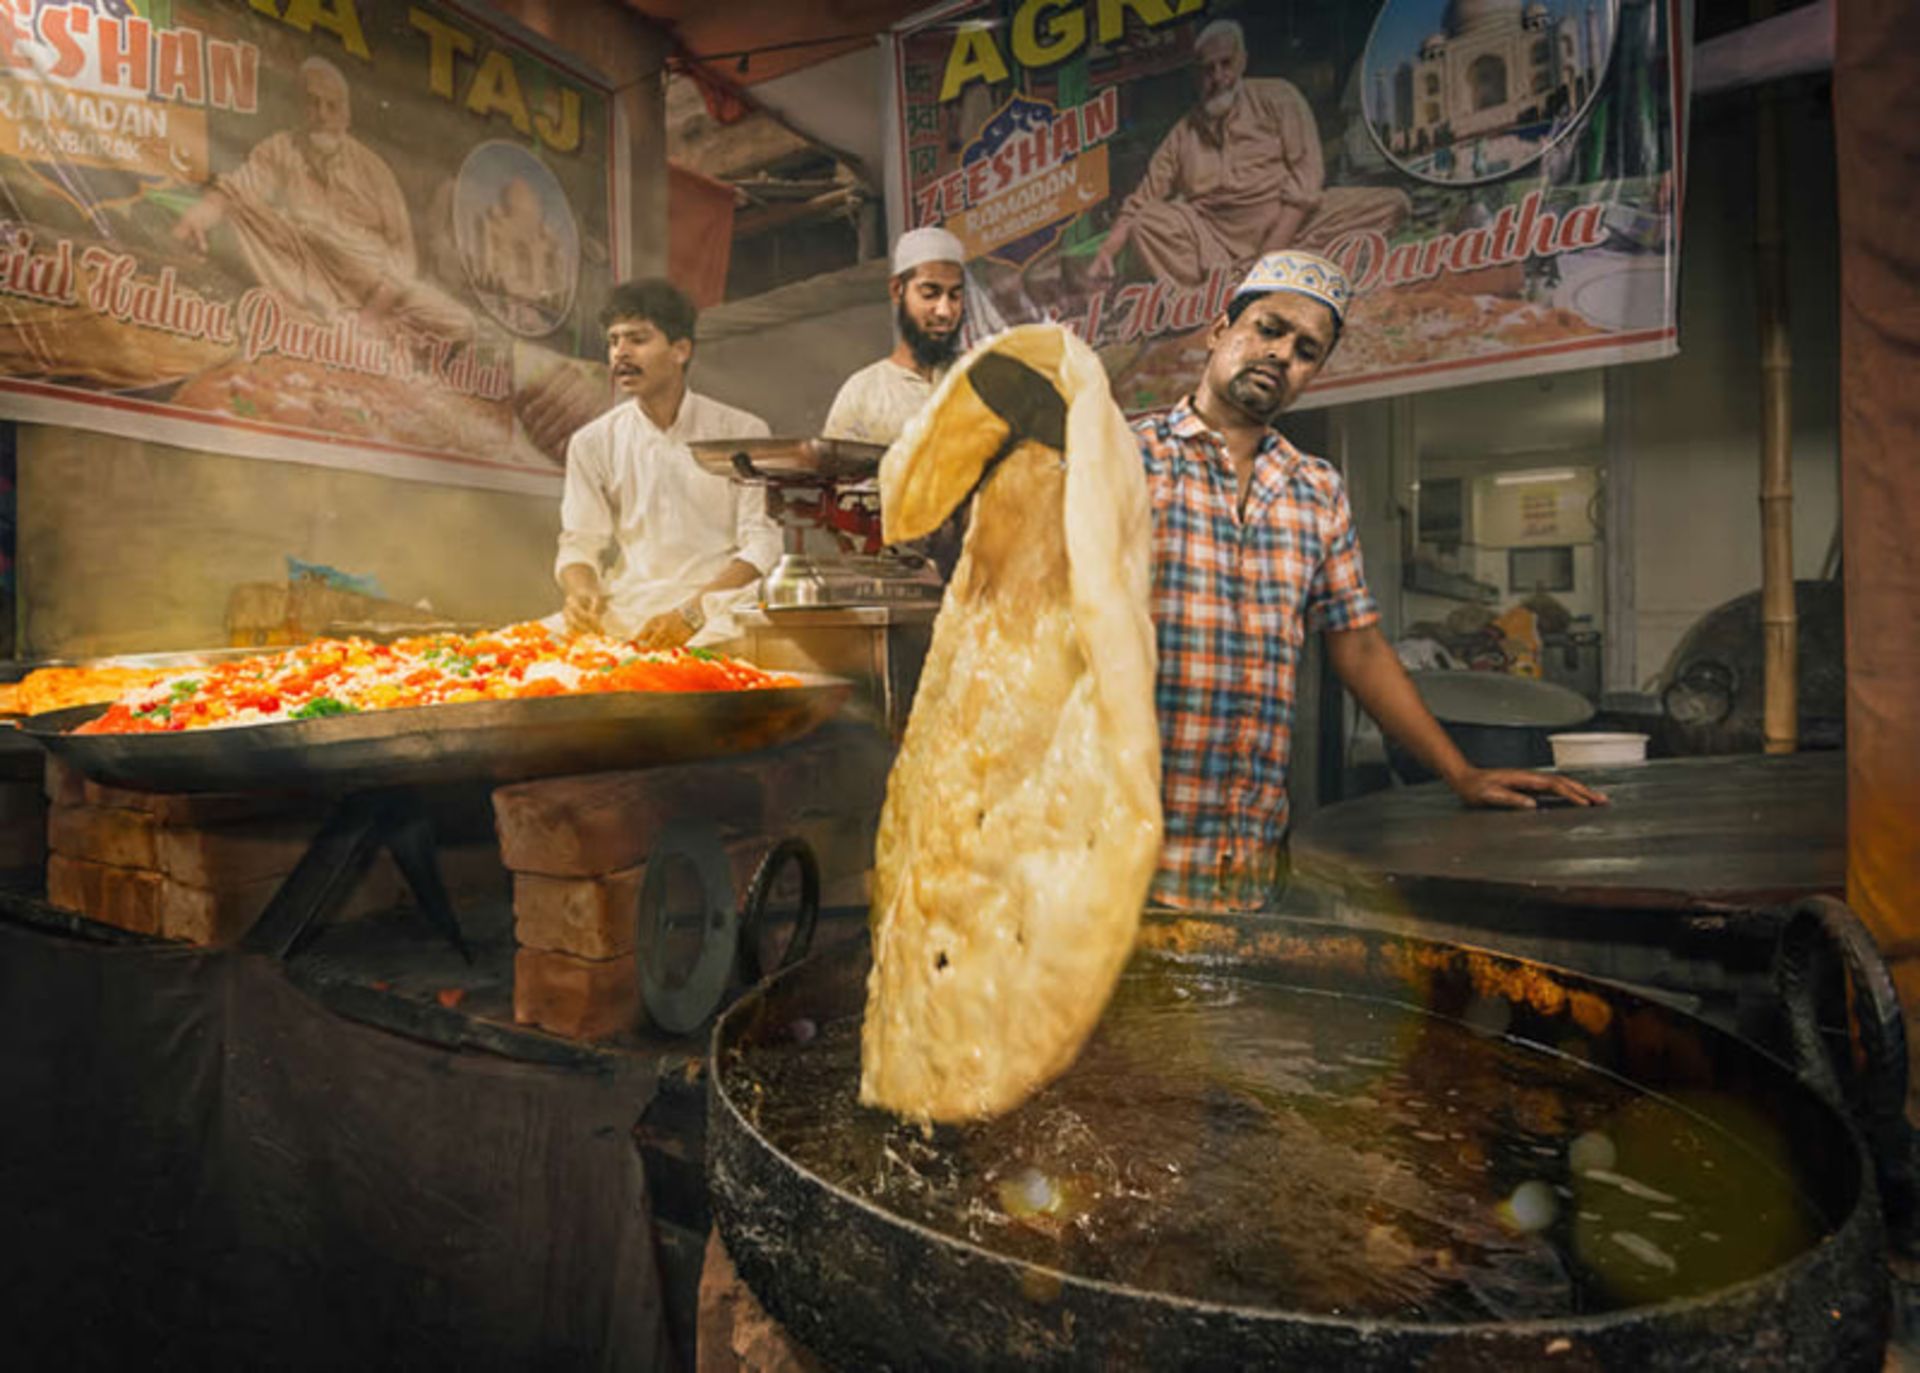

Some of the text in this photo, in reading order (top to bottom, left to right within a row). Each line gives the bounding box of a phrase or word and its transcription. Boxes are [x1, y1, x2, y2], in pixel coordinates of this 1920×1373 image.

[249, 0, 581, 151] A TAJ
[940, 0, 1202, 101] AGR
[917, 86, 1118, 227] ZEESHAN
[80, 246, 234, 342] Halwa
